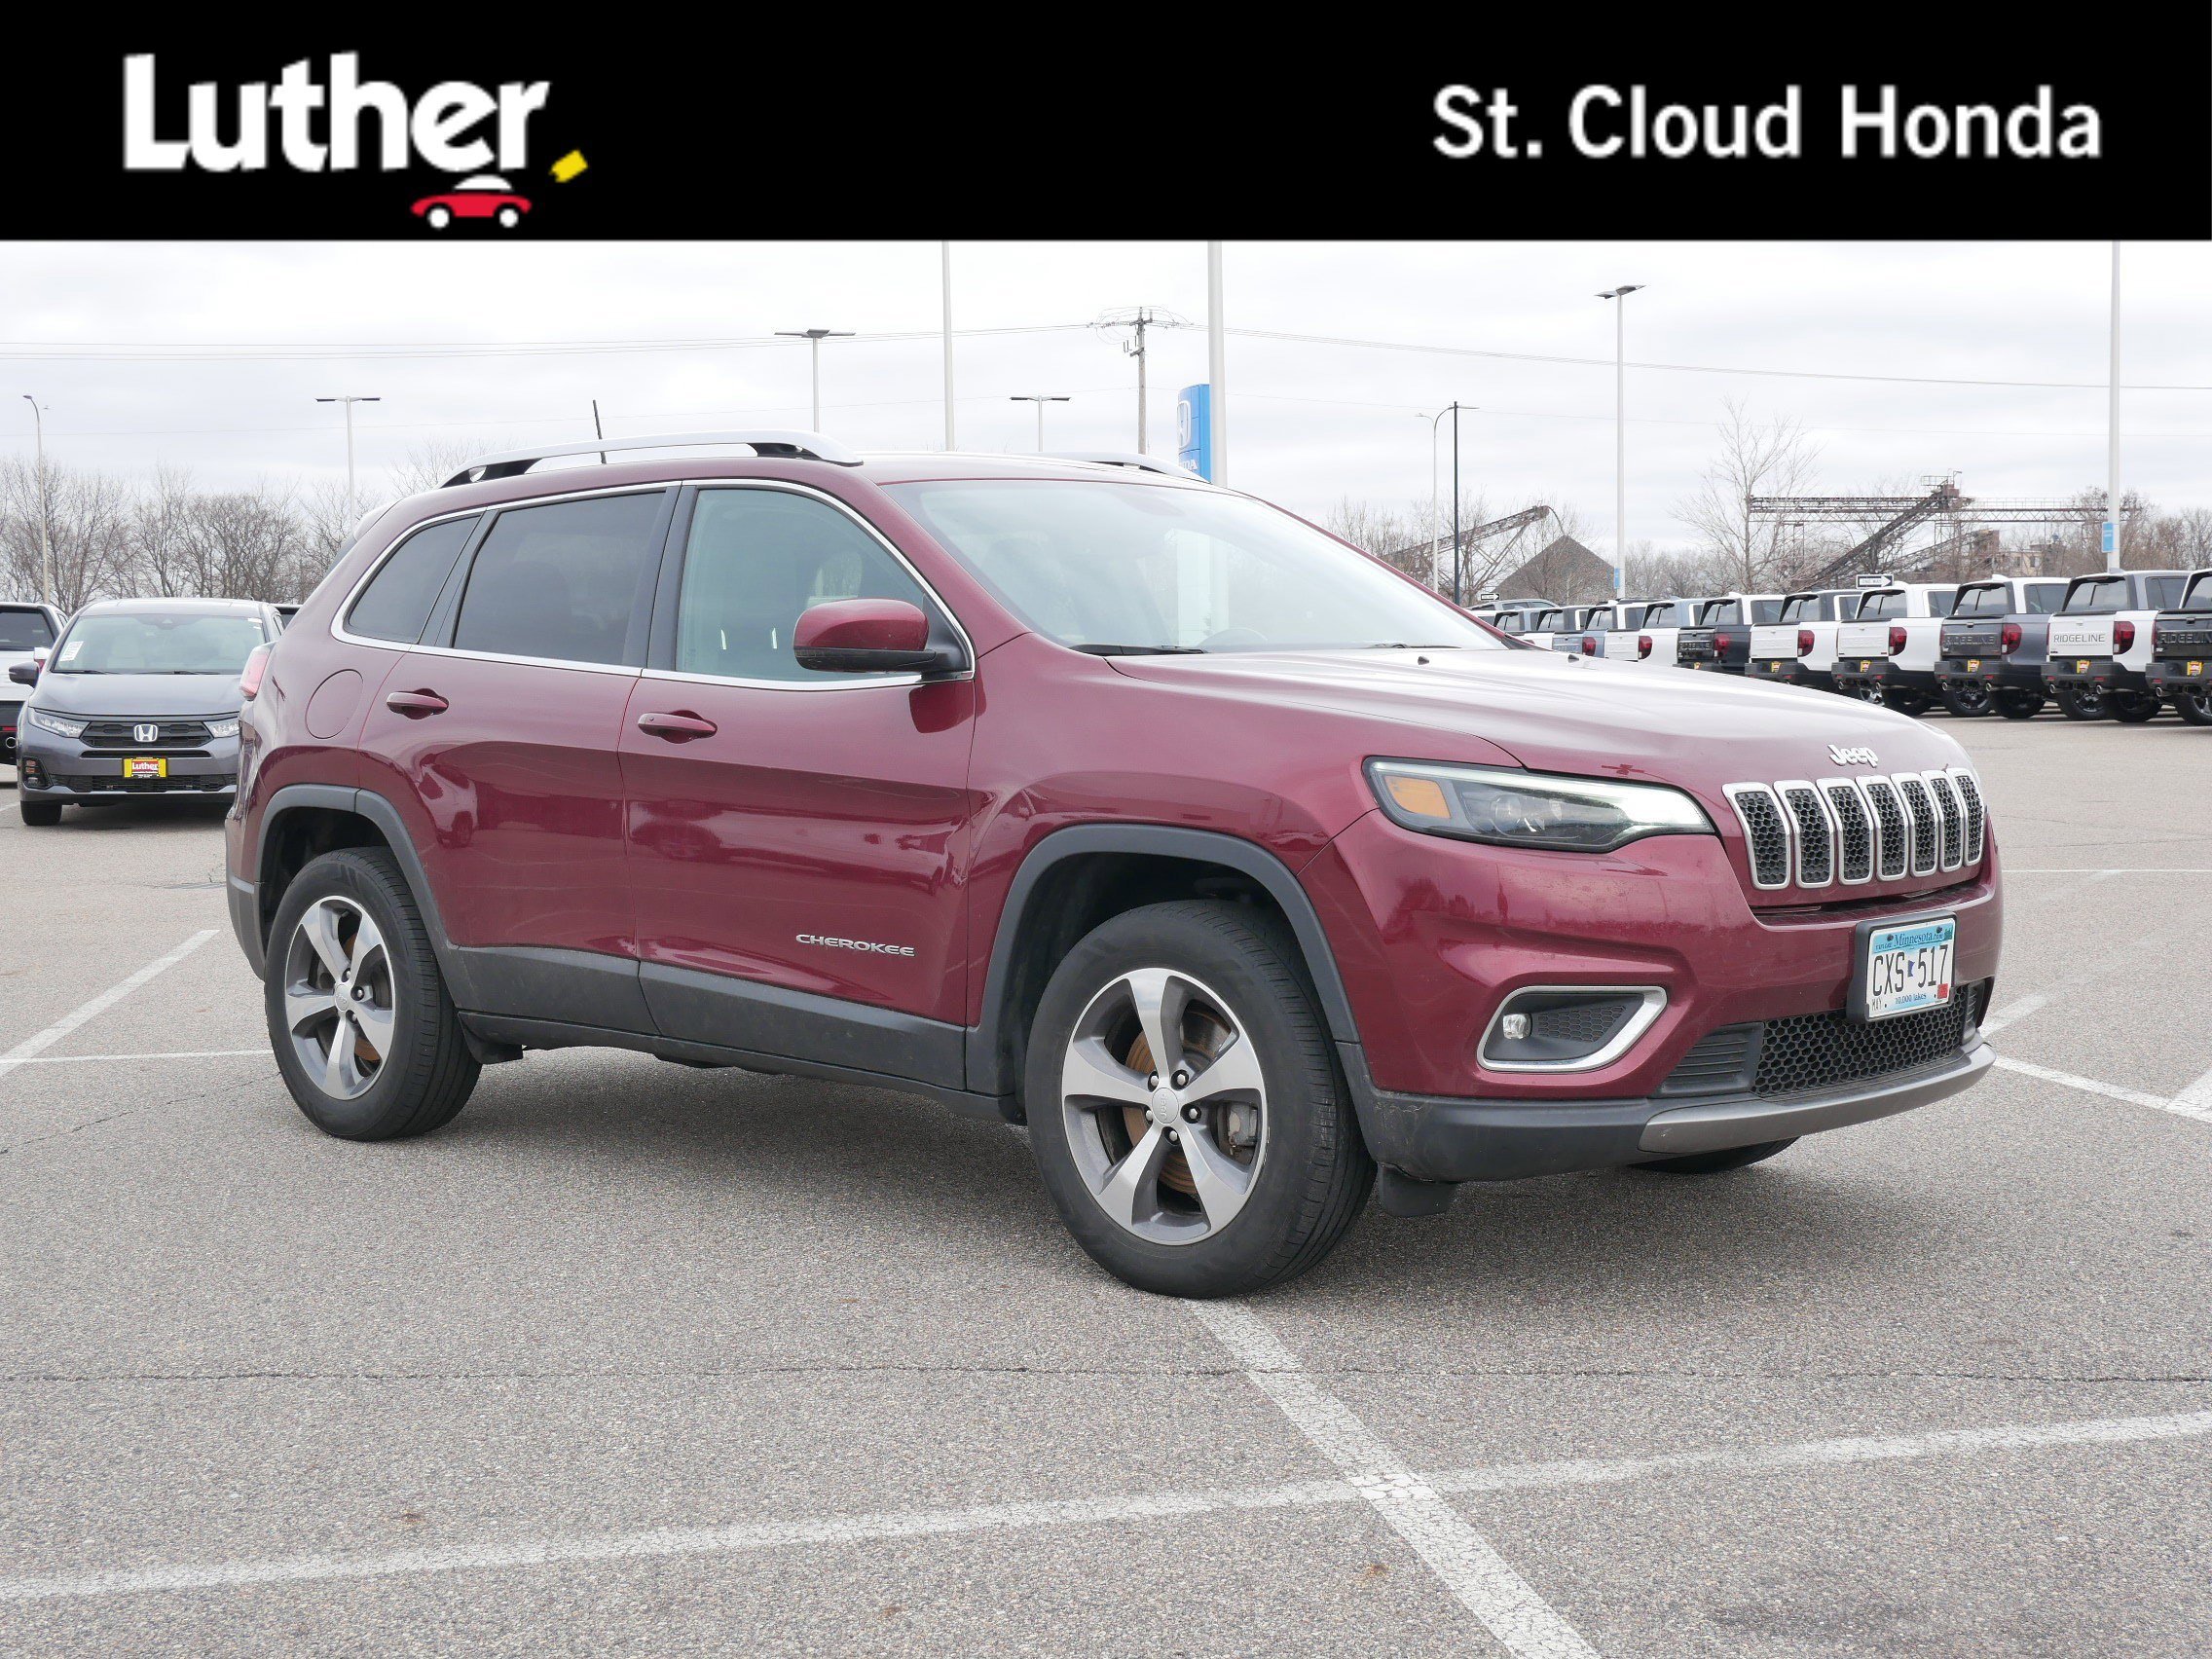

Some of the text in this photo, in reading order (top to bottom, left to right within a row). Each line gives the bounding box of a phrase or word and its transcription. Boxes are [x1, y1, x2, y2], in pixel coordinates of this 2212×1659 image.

[2053, 633, 2106, 644] RIDGELINE
[2159, 633, 2212, 644] RIDGELIN
[1827, 744, 1879, 768] Jeep
[131, 761, 159, 770] Luther
[1894, 932, 1933, 945] Minnesota
[795, 934, 915, 956] CHEROKEE
[1872, 943, 1948, 997] CXS 517
[1913, 993, 1927, 1002] lakes
